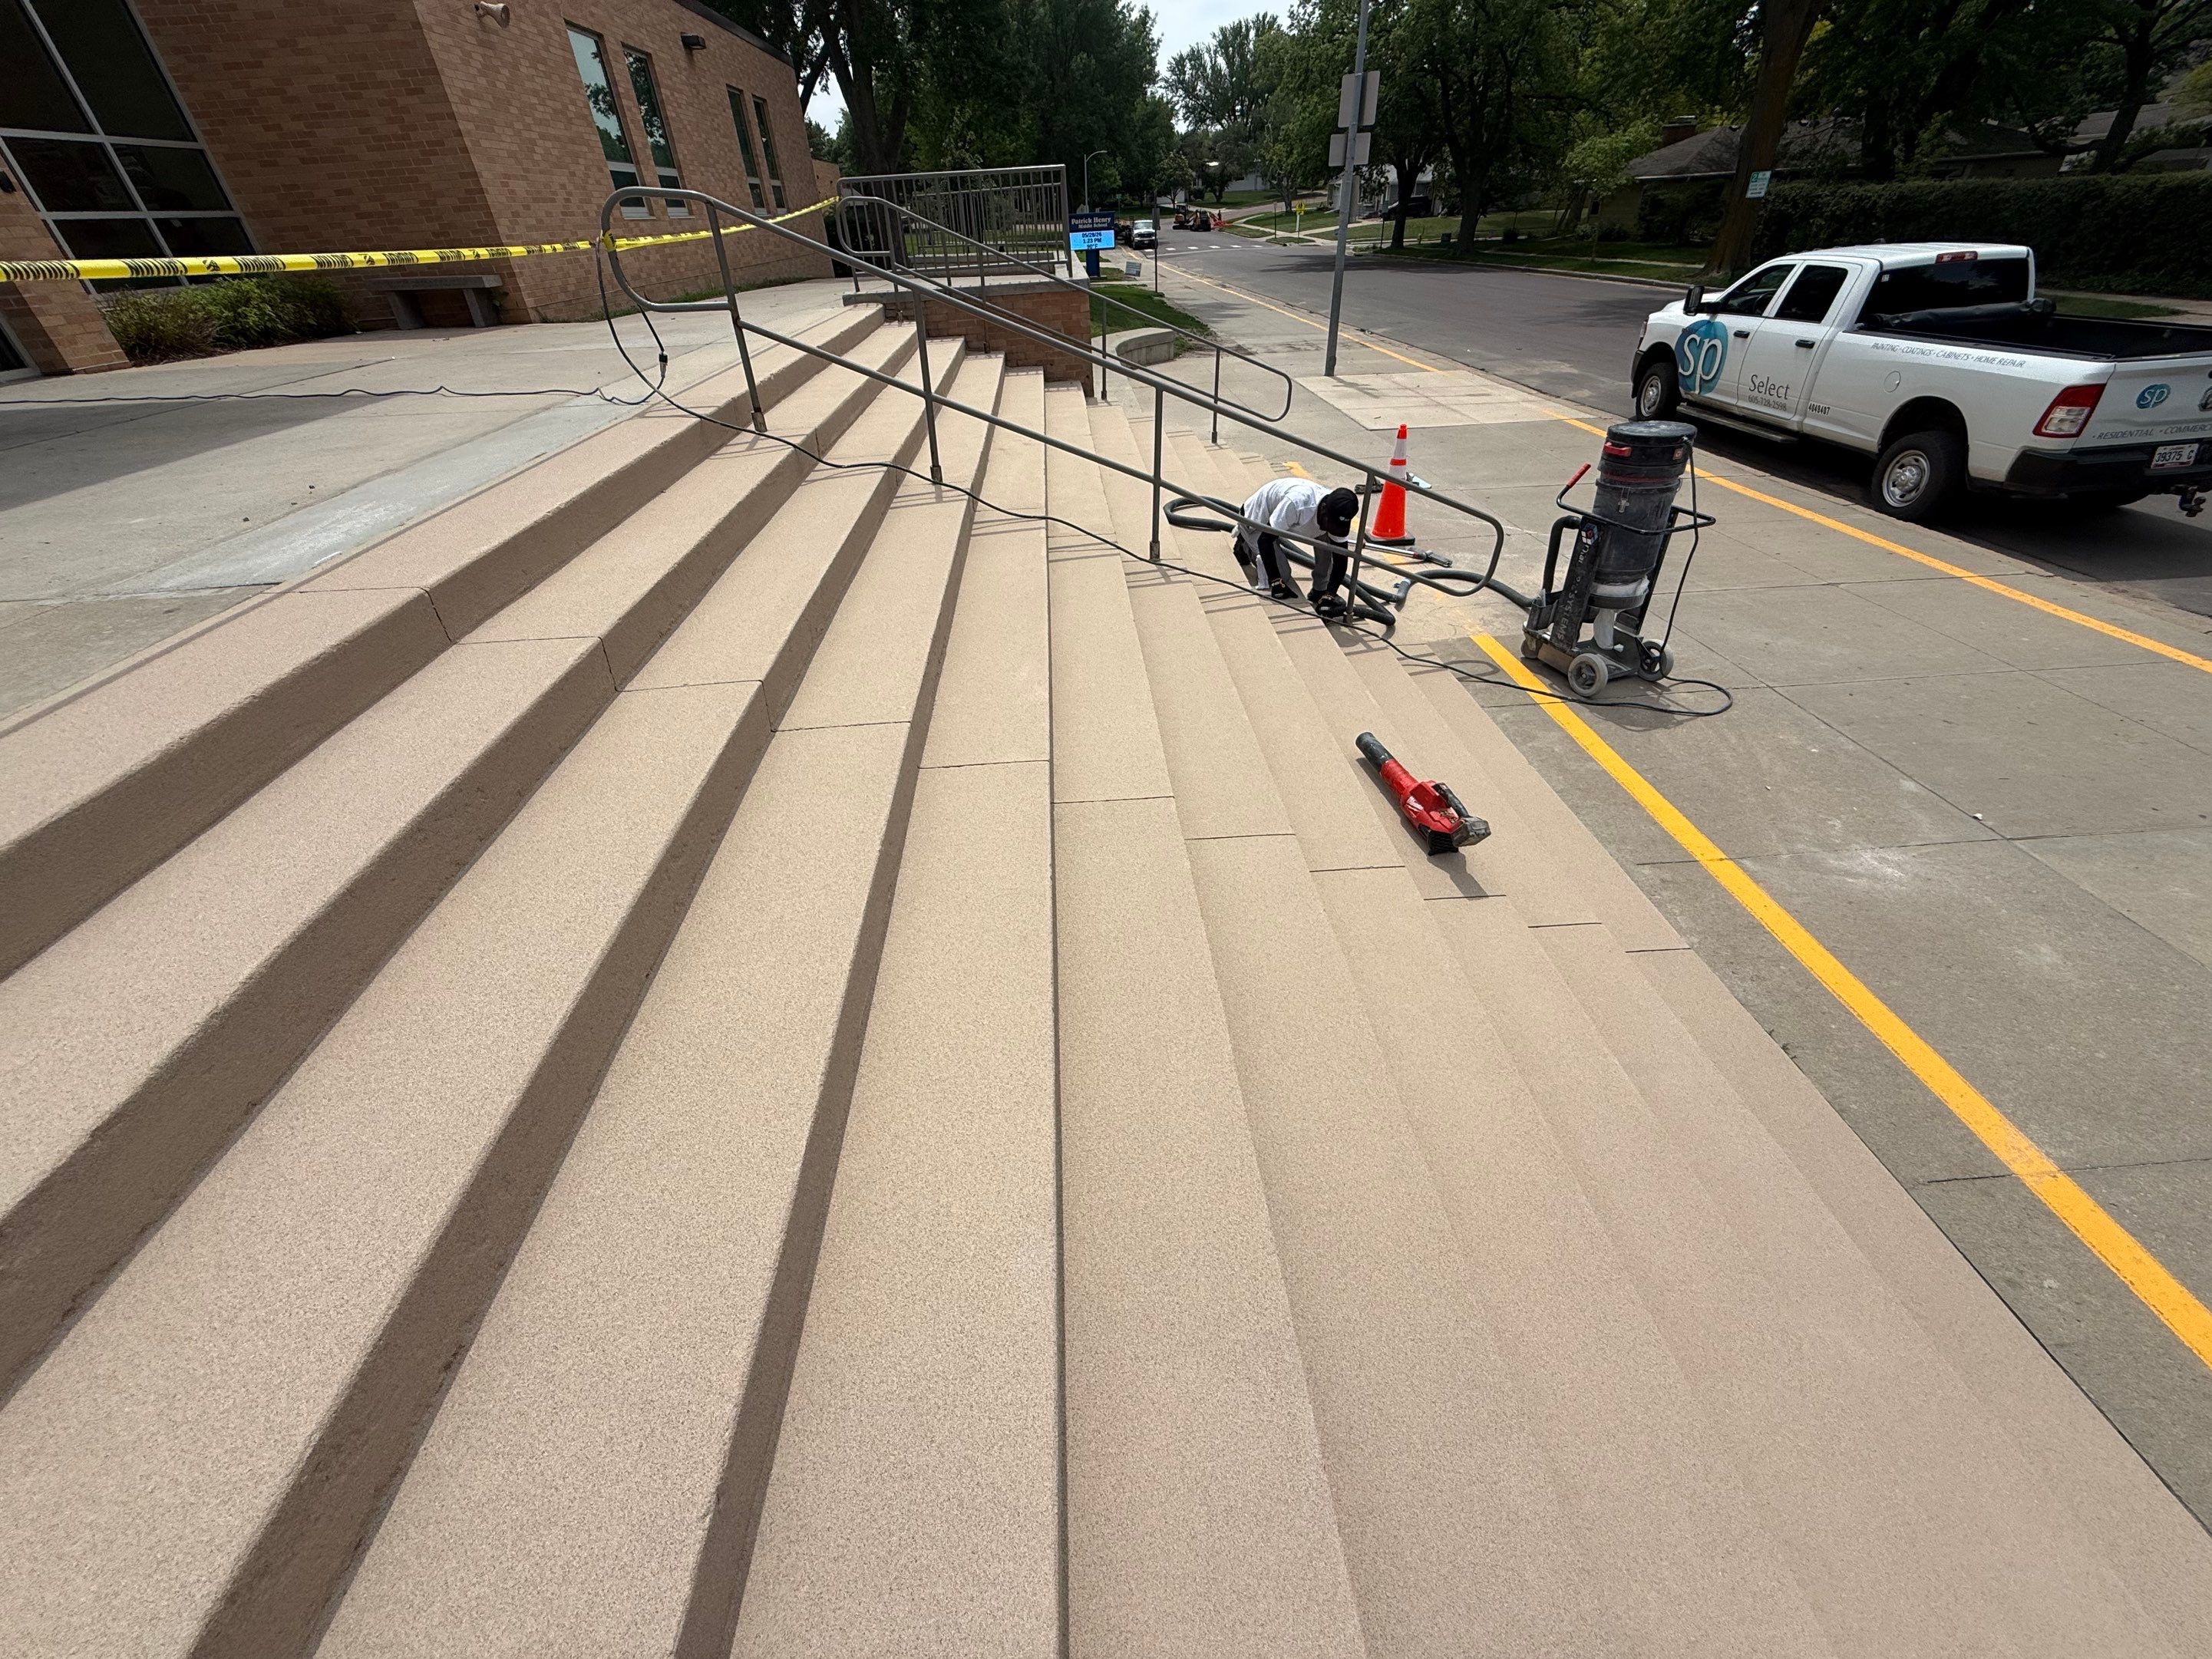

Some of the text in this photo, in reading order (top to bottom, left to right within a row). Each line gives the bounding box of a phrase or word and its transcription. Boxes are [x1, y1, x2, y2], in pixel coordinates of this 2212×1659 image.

[1871, 342, 2026, 368] PAINTING COATINGS CABINETS HOME REPAIR
[1749, 374, 1790, 400] Select
[1748, 395, 1787, 411] 605-728-2598
[2096, 429, 2154, 440] RESIDENTIAL
[2155, 451, 2183, 463] 39375
